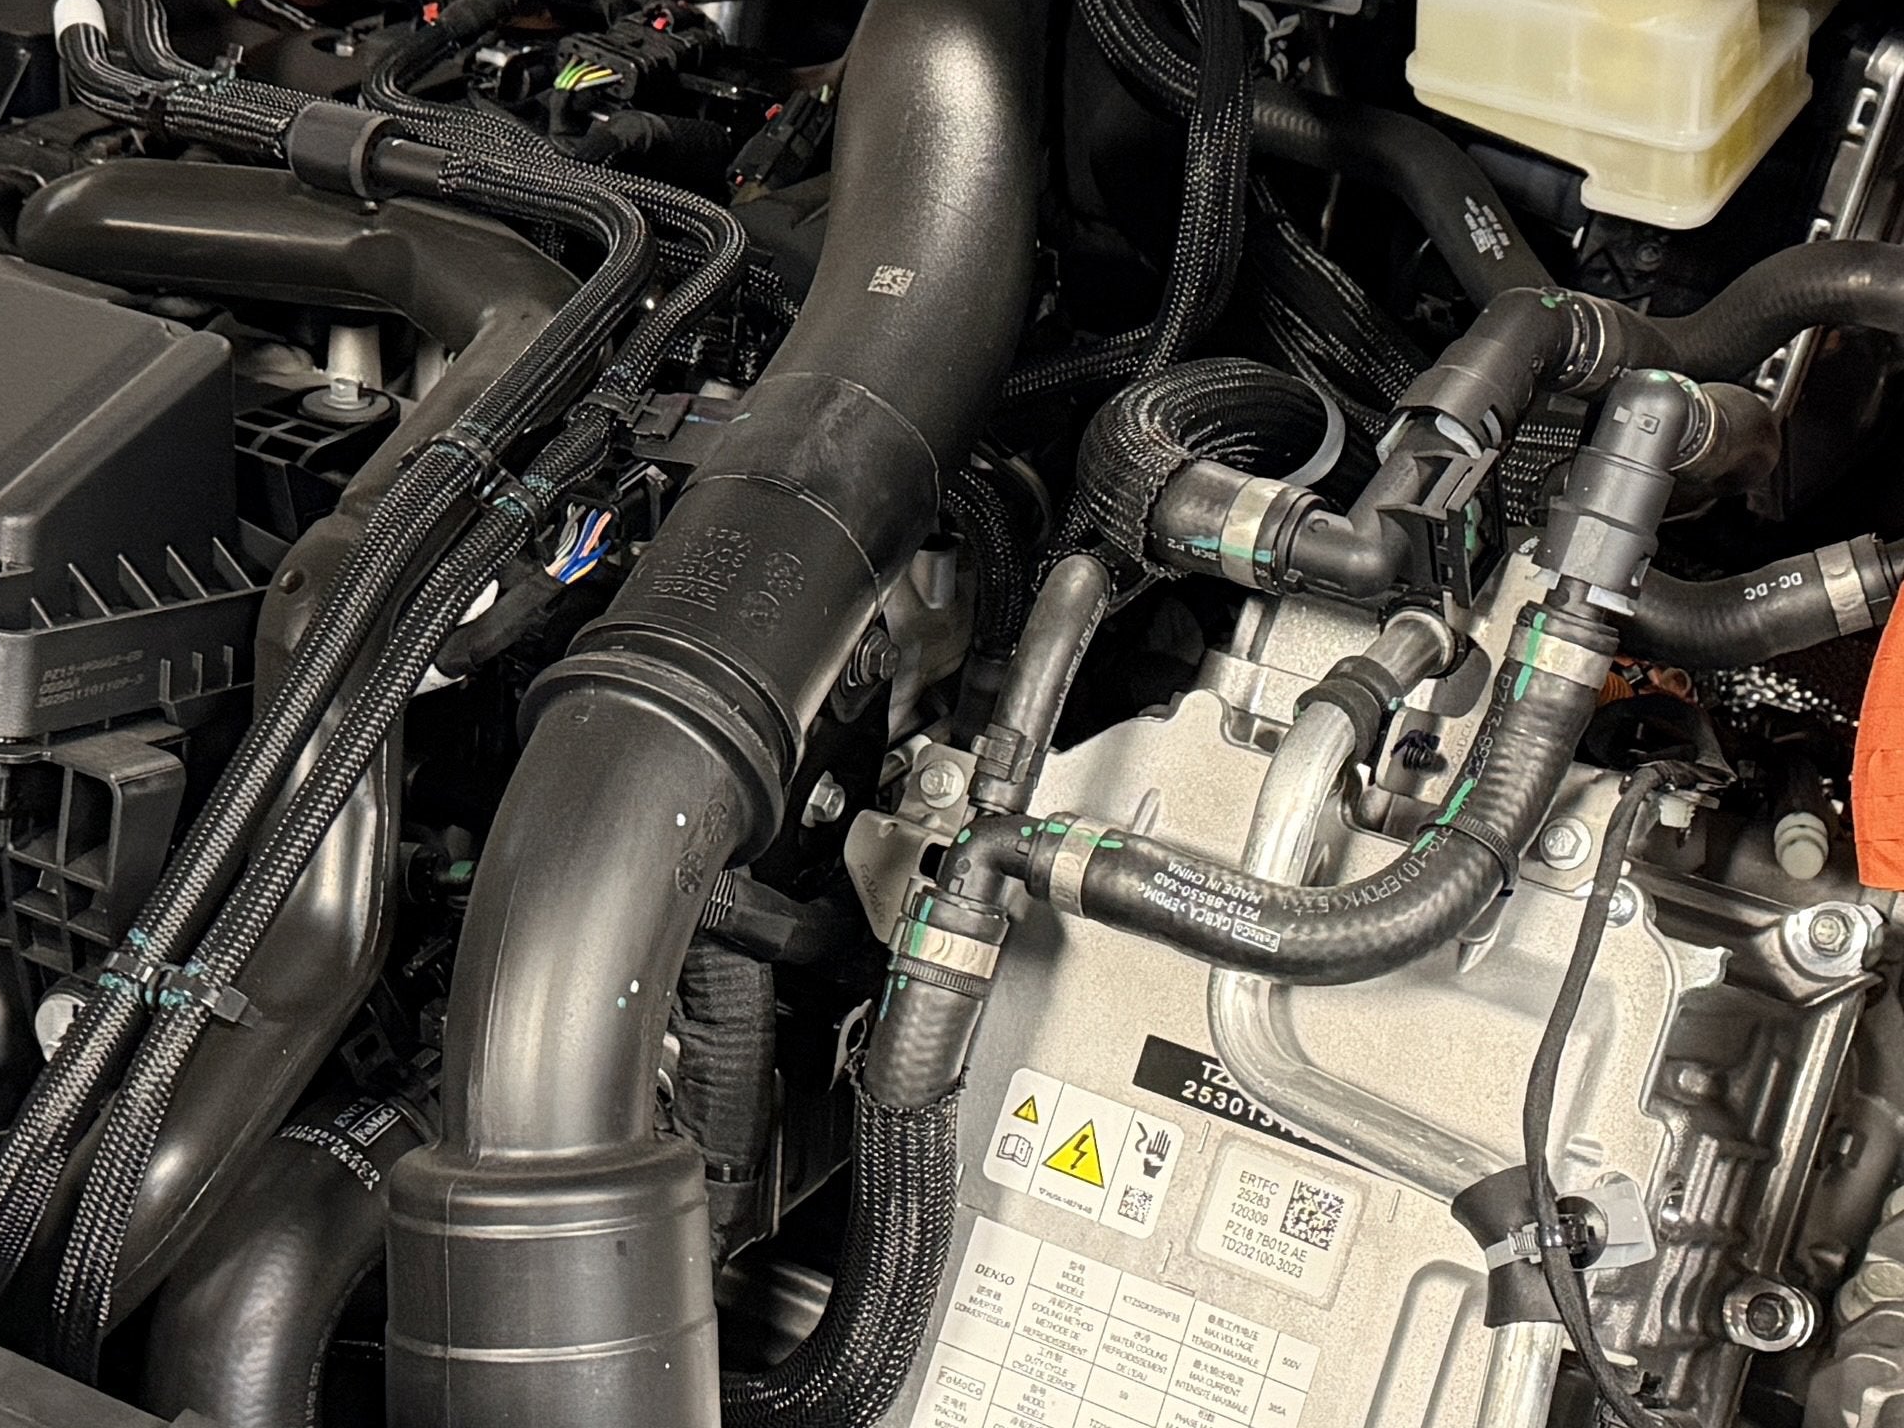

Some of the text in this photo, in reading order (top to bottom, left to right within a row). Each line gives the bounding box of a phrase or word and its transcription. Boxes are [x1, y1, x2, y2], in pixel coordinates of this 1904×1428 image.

[1167, 860, 1263, 904] MADE IN CHINA
[1188, 900, 1232, 931] GKBCA
[1233, 923, 1279, 947] FoMoCo
[1238, 1169, 1280, 1196] ERTFC
[1236, 1186, 1271, 1209] 25283
[1230, 1201, 1269, 1226] 120309
[1224, 1219, 1308, 1263] PZ18 7B012 AE
[1221, 1234, 1303, 1278] TD232100-3023
[974, 1262, 1015, 1286] DENSO
[1060, 1269, 1084, 1286] MODEL
[1030, 1301, 1094, 1332] COOLING METHOD
[937, 1369, 984, 1396] FoMoCo
[933, 1403, 968, 1424] TRACTION
[1021, 1392, 1045, 1409] MODEL
